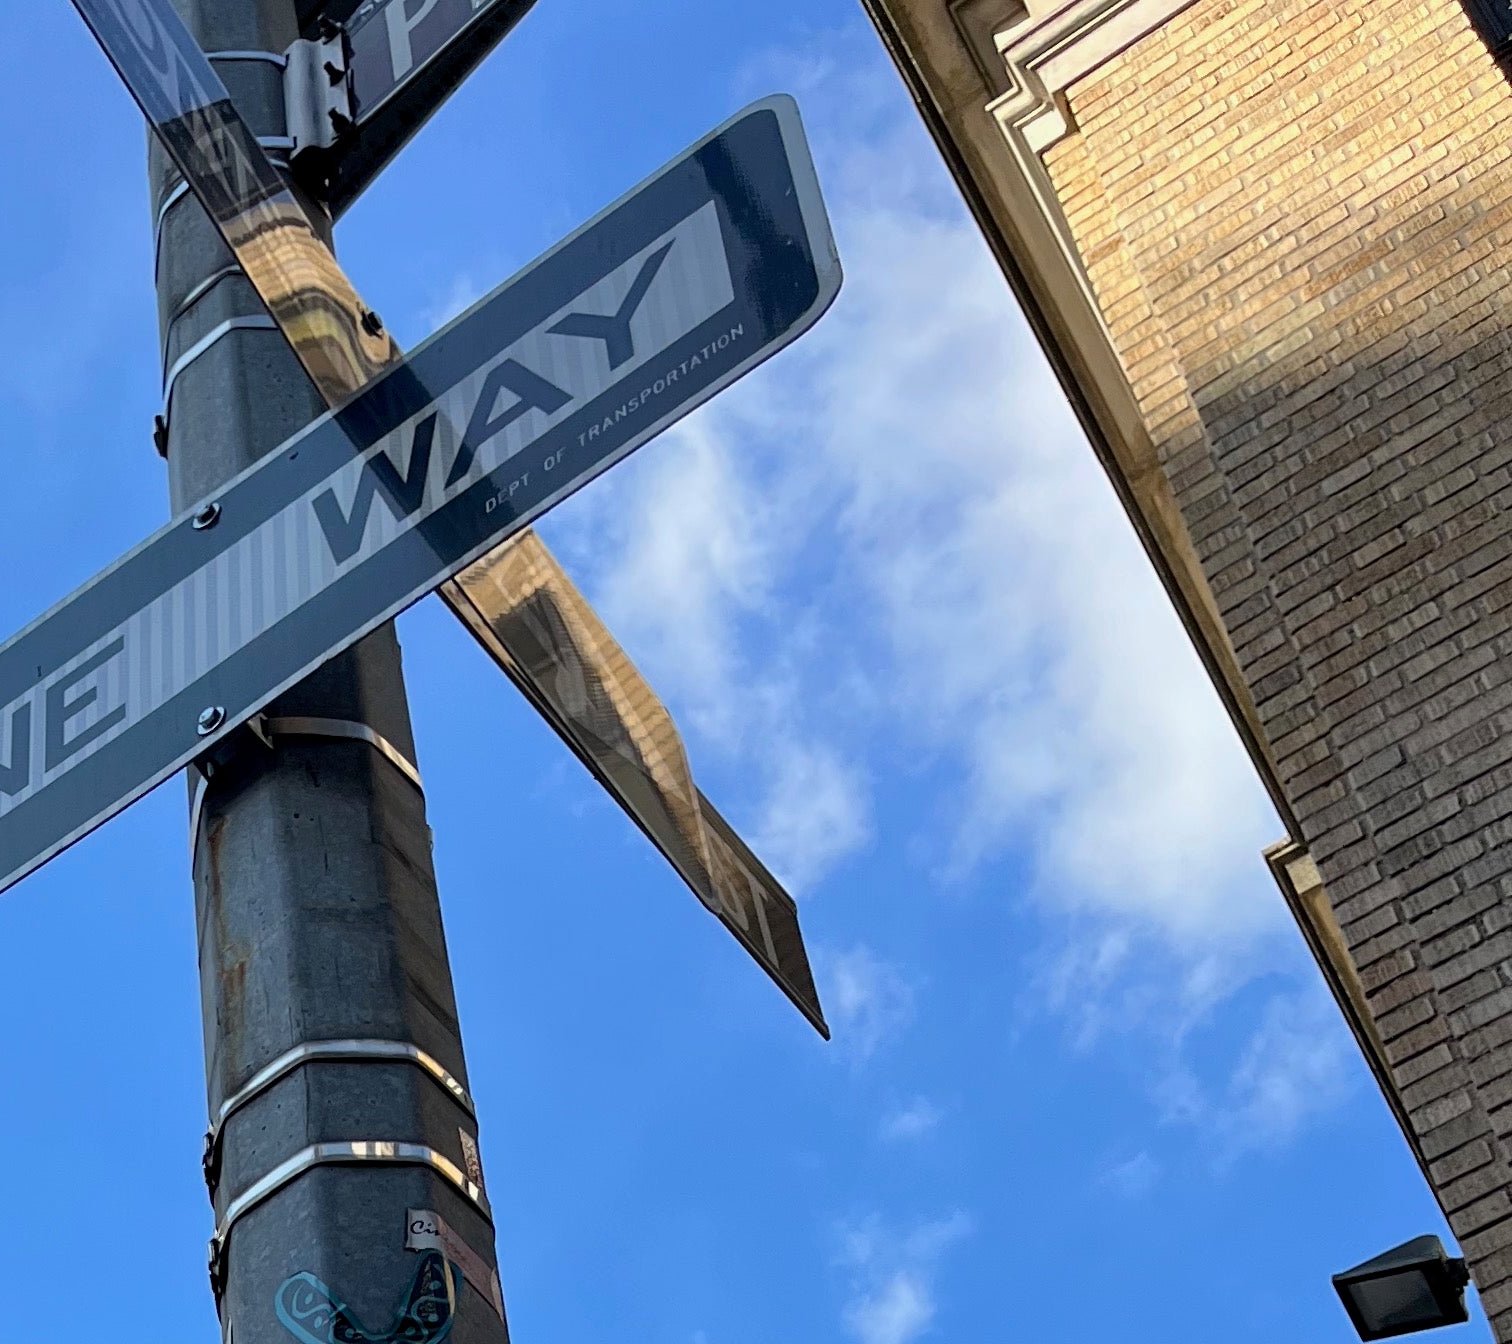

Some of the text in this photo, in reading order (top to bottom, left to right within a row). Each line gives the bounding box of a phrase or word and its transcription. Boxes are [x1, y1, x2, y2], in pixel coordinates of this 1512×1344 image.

[309, 238, 678, 568] WAY
[485, 323, 745, 514] DEPT OF TRANSPORTATION
